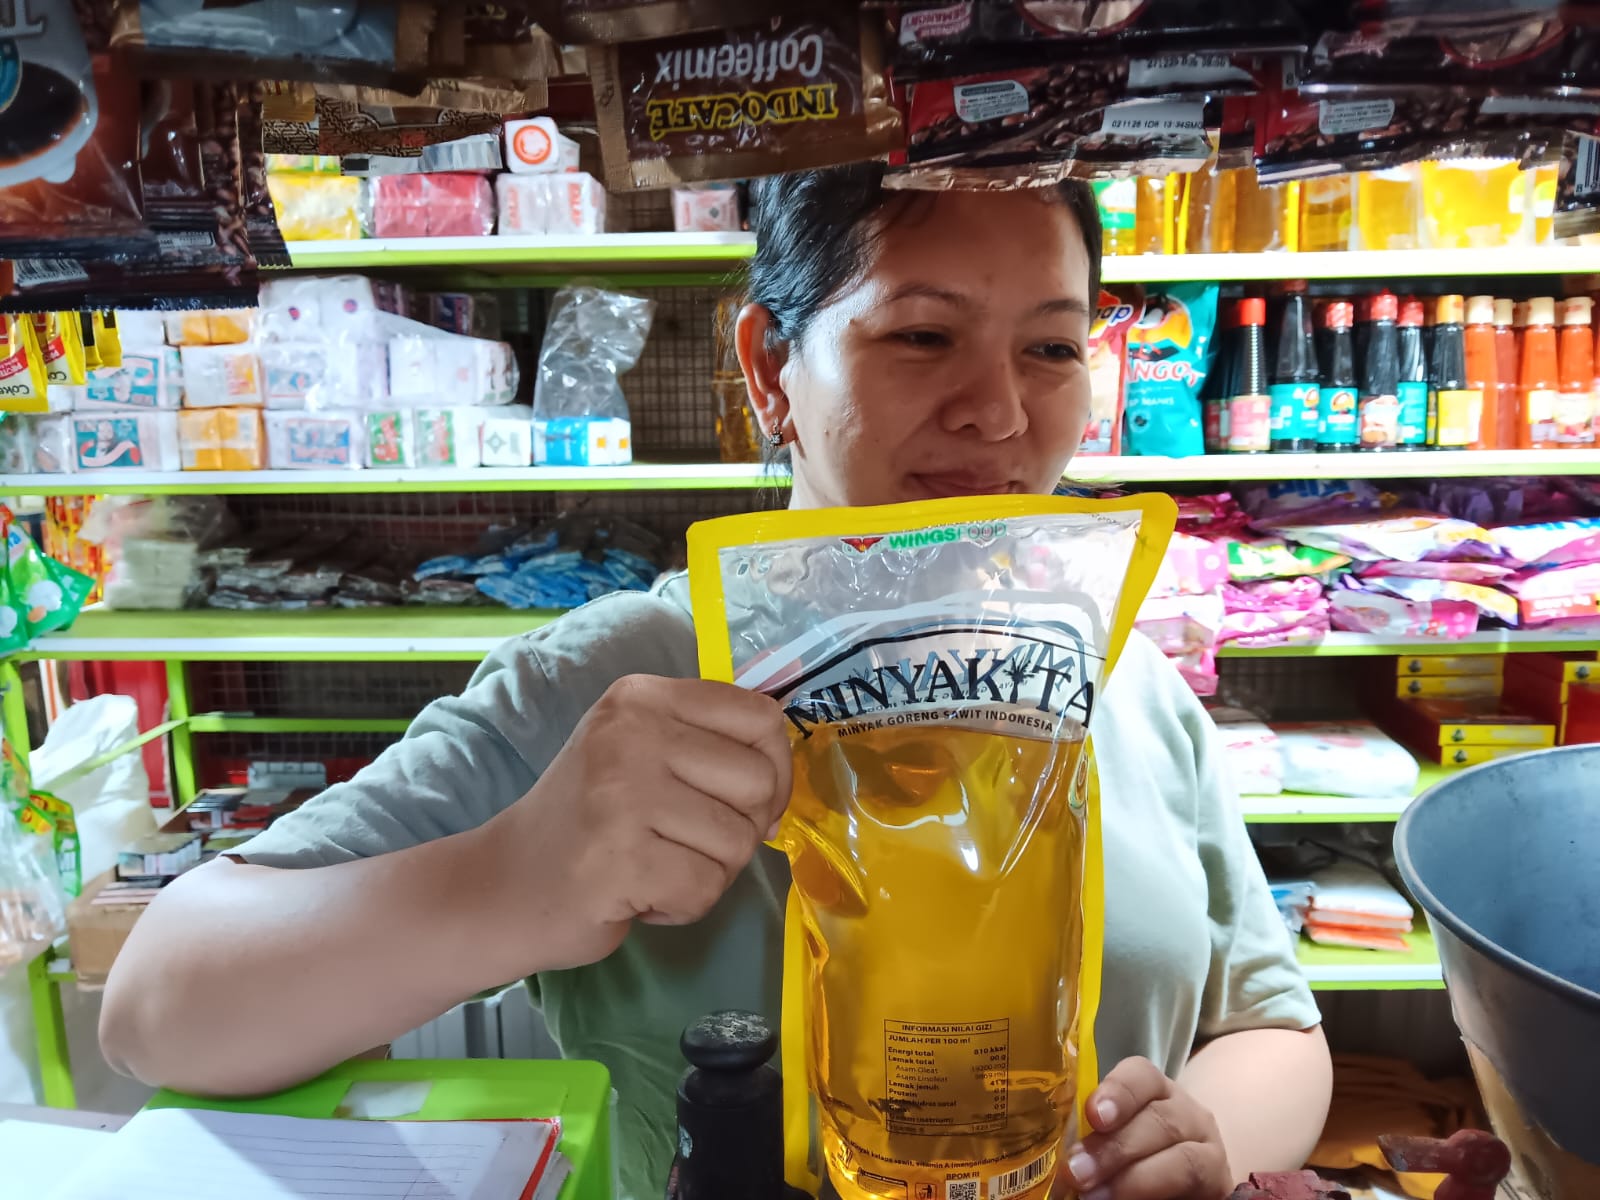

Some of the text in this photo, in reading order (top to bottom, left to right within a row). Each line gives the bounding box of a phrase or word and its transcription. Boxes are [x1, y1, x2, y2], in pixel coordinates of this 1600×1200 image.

[655, 34, 824, 90] Coffeemix
[646, 84, 839, 141] INDOCAFÉ
[838, 709, 1054, 738] MINYAK GORENG SAWIT INDONESIA
[901, 1023, 992, 1033] INFORMASI NILAI GIZI
[888, 1034, 924, 1043] JUMLAH
[888, 1046, 914, 1057] Energi
[915, 1049, 935, 1057] total
[888, 1056, 914, 1065] Lemak
[946, 1172, 973, 1180] BPOM
